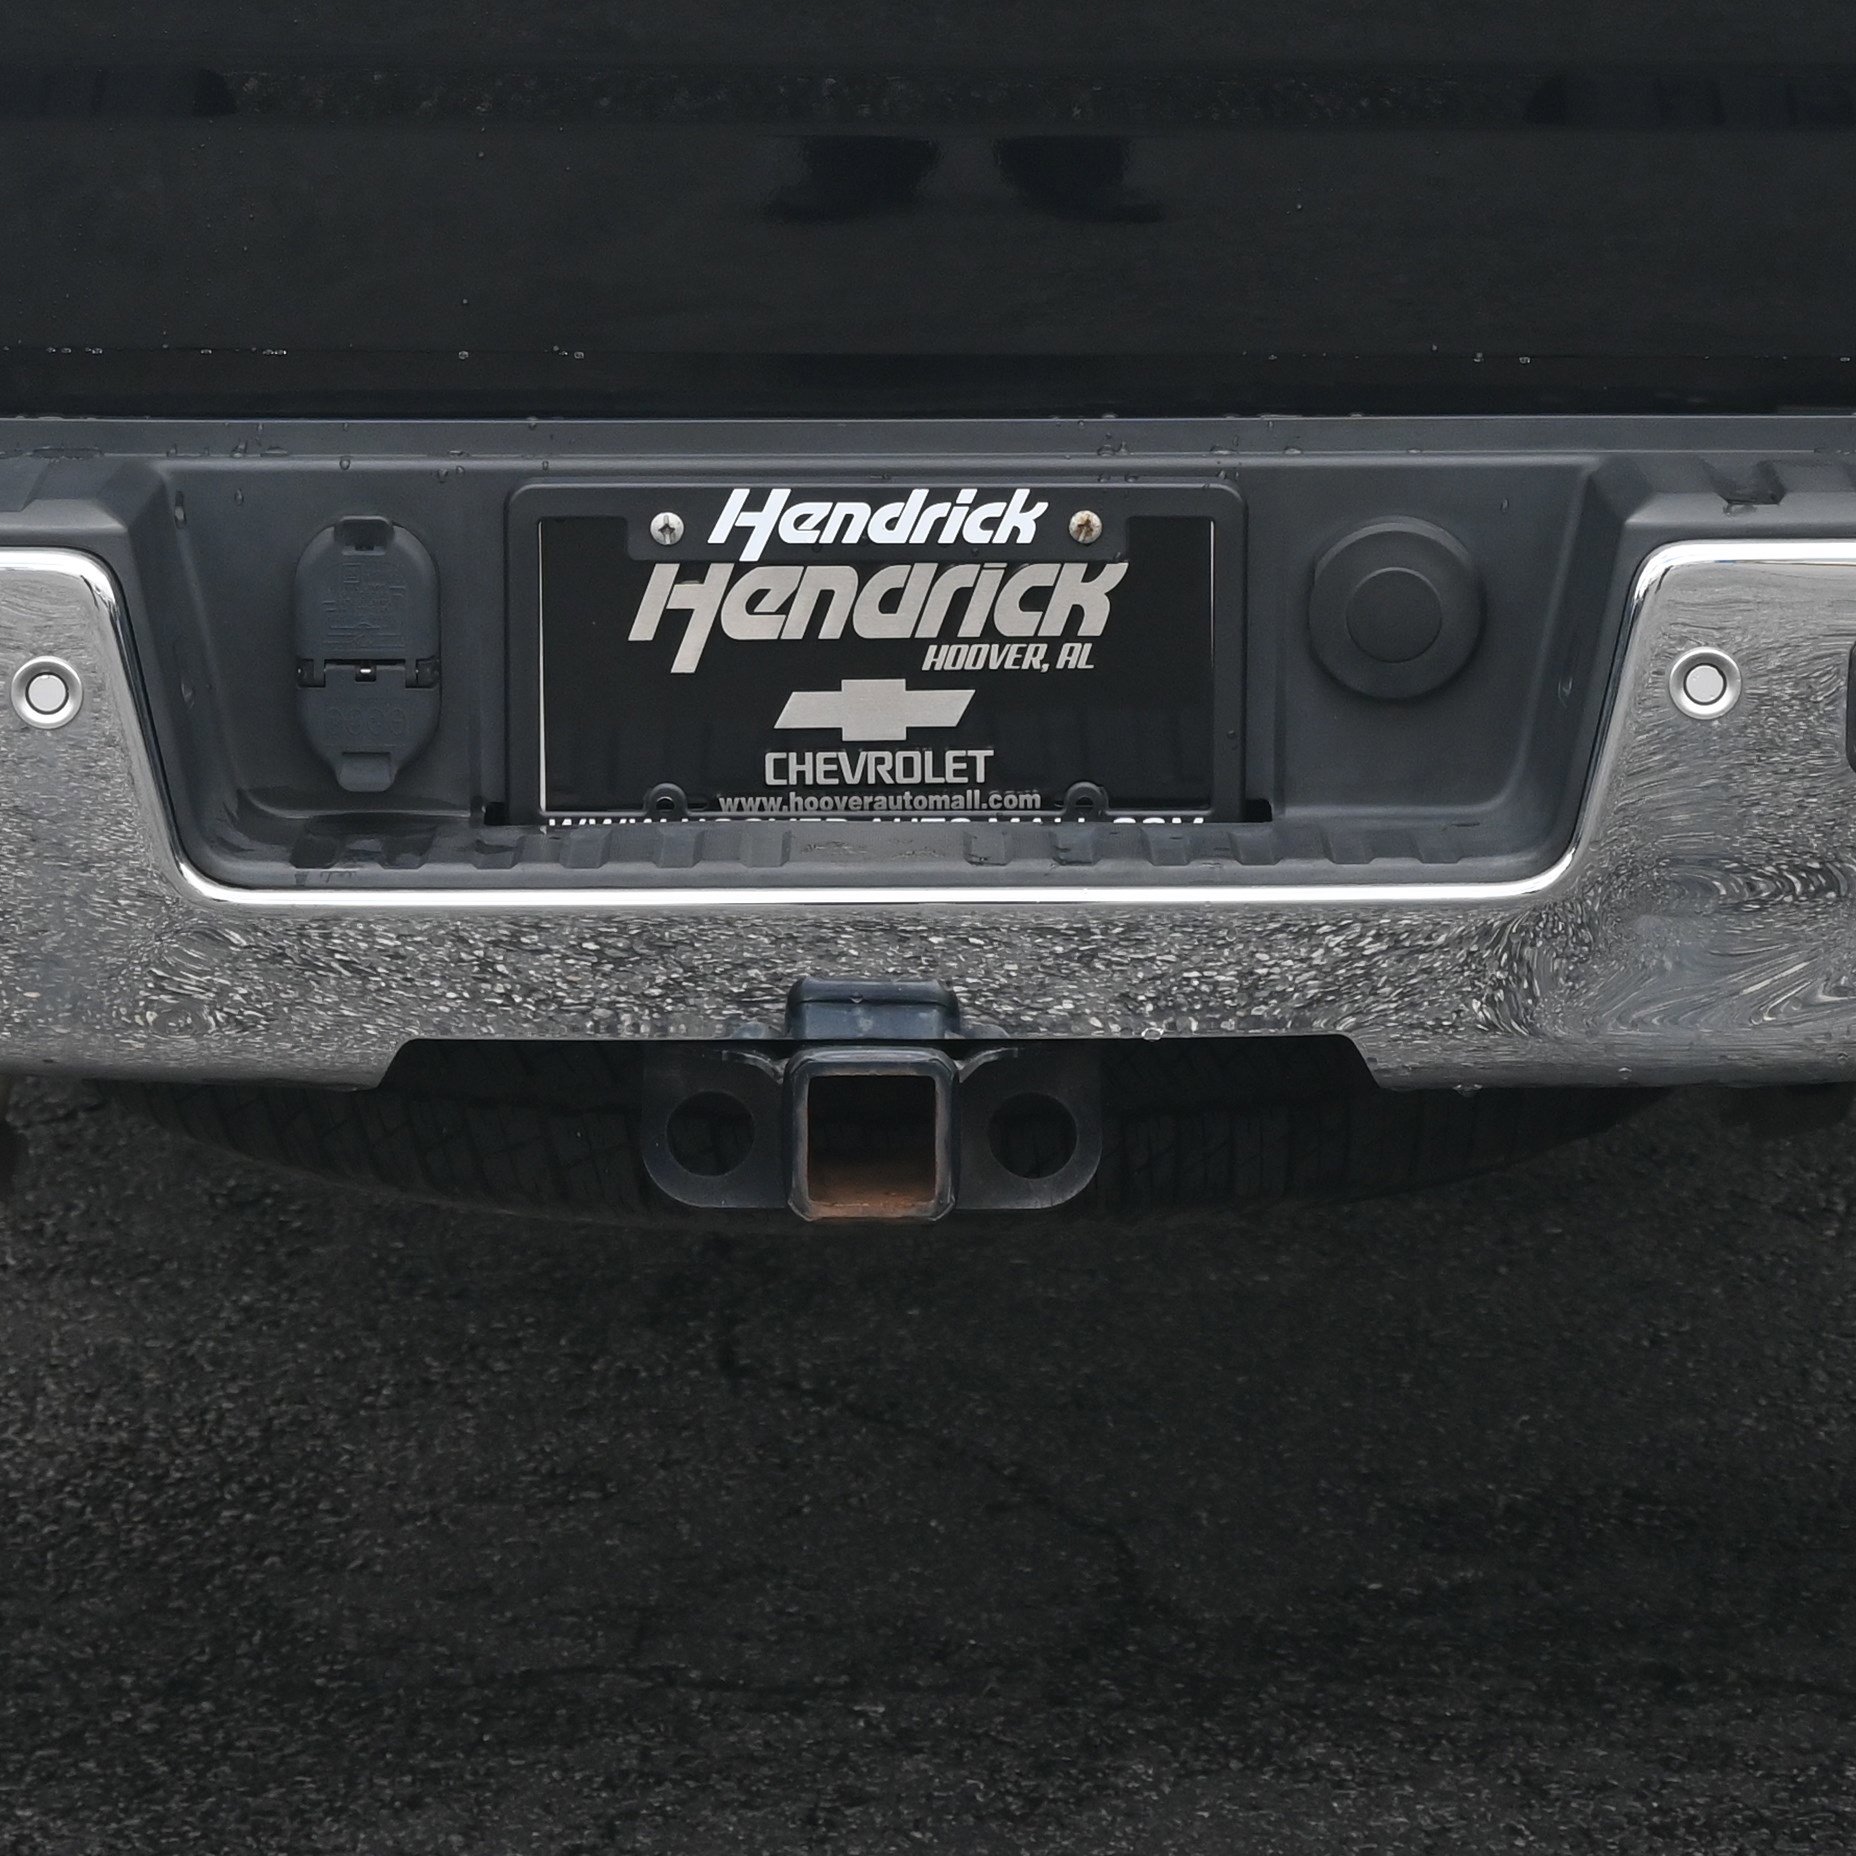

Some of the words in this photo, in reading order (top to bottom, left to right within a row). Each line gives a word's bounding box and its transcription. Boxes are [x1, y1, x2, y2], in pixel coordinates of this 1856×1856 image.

[707, 488, 1048, 561] Hendrick
[628, 562, 1128, 674] Hendrick
[921, 644, 1049, 673] HOOVER,
[1055, 644, 1095, 670] AL
[764, 750, 995, 786] CHEVROLET
[718, 790, 1042, 813] www.hooverautomall.com
